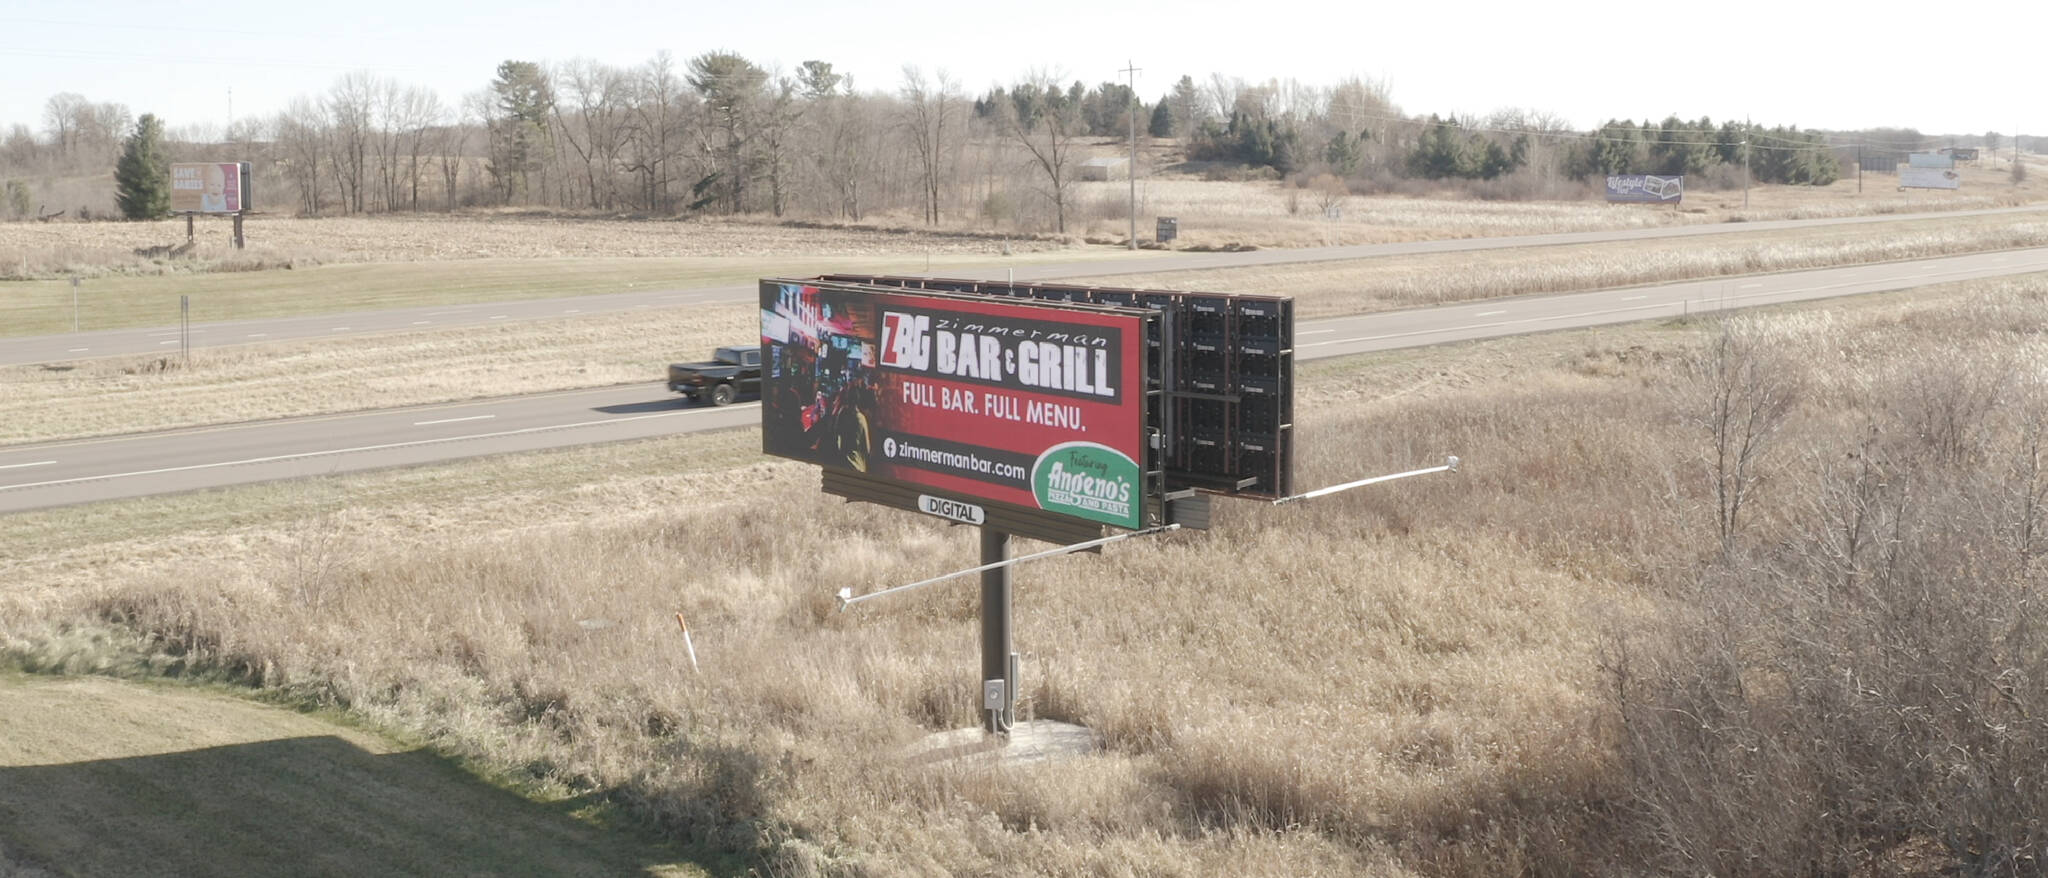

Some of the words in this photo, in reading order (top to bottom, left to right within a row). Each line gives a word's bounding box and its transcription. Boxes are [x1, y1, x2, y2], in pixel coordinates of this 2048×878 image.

[880, 311, 931, 371] ZBG
[936, 318, 1107, 347] zimmerman
[936, 330, 1002, 381] BAR
[1005, 348, 1016, 374] &
[1018, 340, 1114, 396] GRILL
[903, 381, 936, 408] FULL
[942, 387, 979, 414] BAR.
[985, 393, 1021, 421] FULL
[1026, 400, 1086, 431] MENU.
[899, 442, 1025, 480] zimmermanbar.com
[1069, 451, 1108, 476] Featuring
[1048, 461, 1130, 505] Angeno's
[930, 498, 976, 522] DIGITAL
